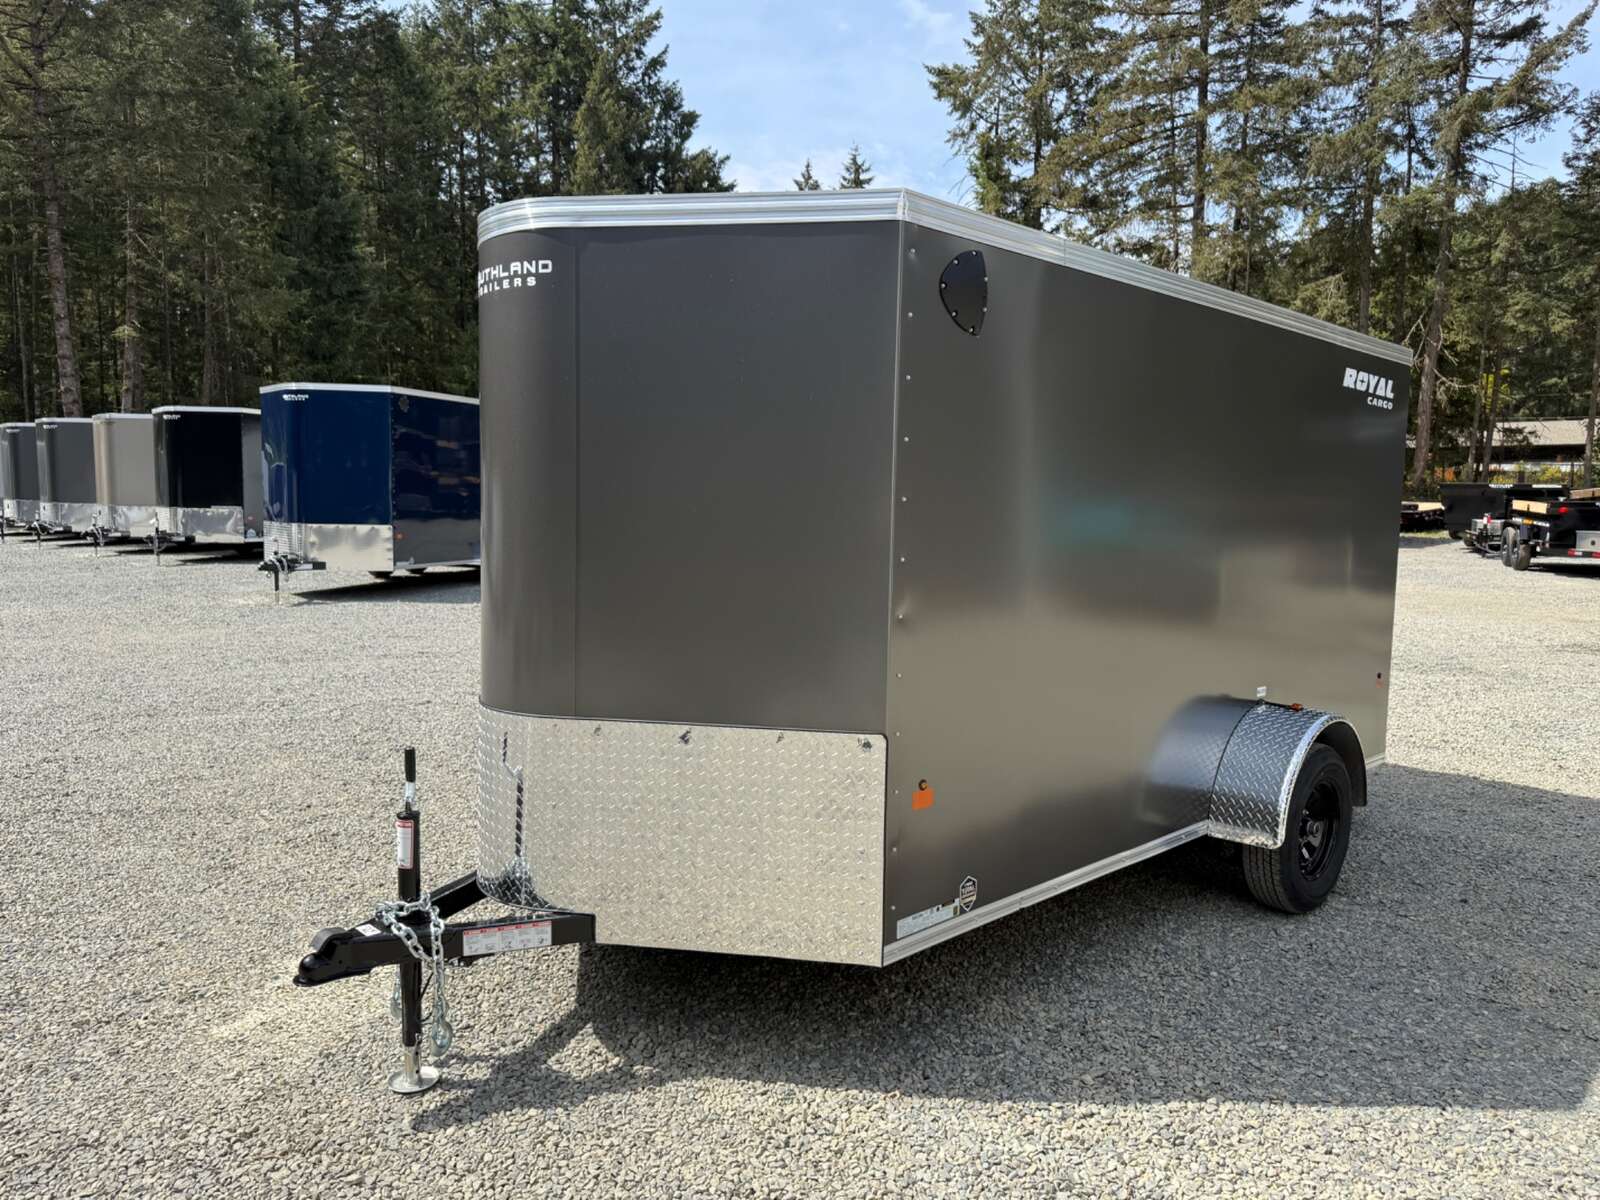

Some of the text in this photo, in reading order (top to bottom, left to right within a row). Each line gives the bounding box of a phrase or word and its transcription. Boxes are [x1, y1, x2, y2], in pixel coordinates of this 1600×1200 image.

[478, 259, 552, 285] UTHLAND
[1342, 366, 1395, 399] ROYAL
[1367, 397, 1393, 410] CARGO
